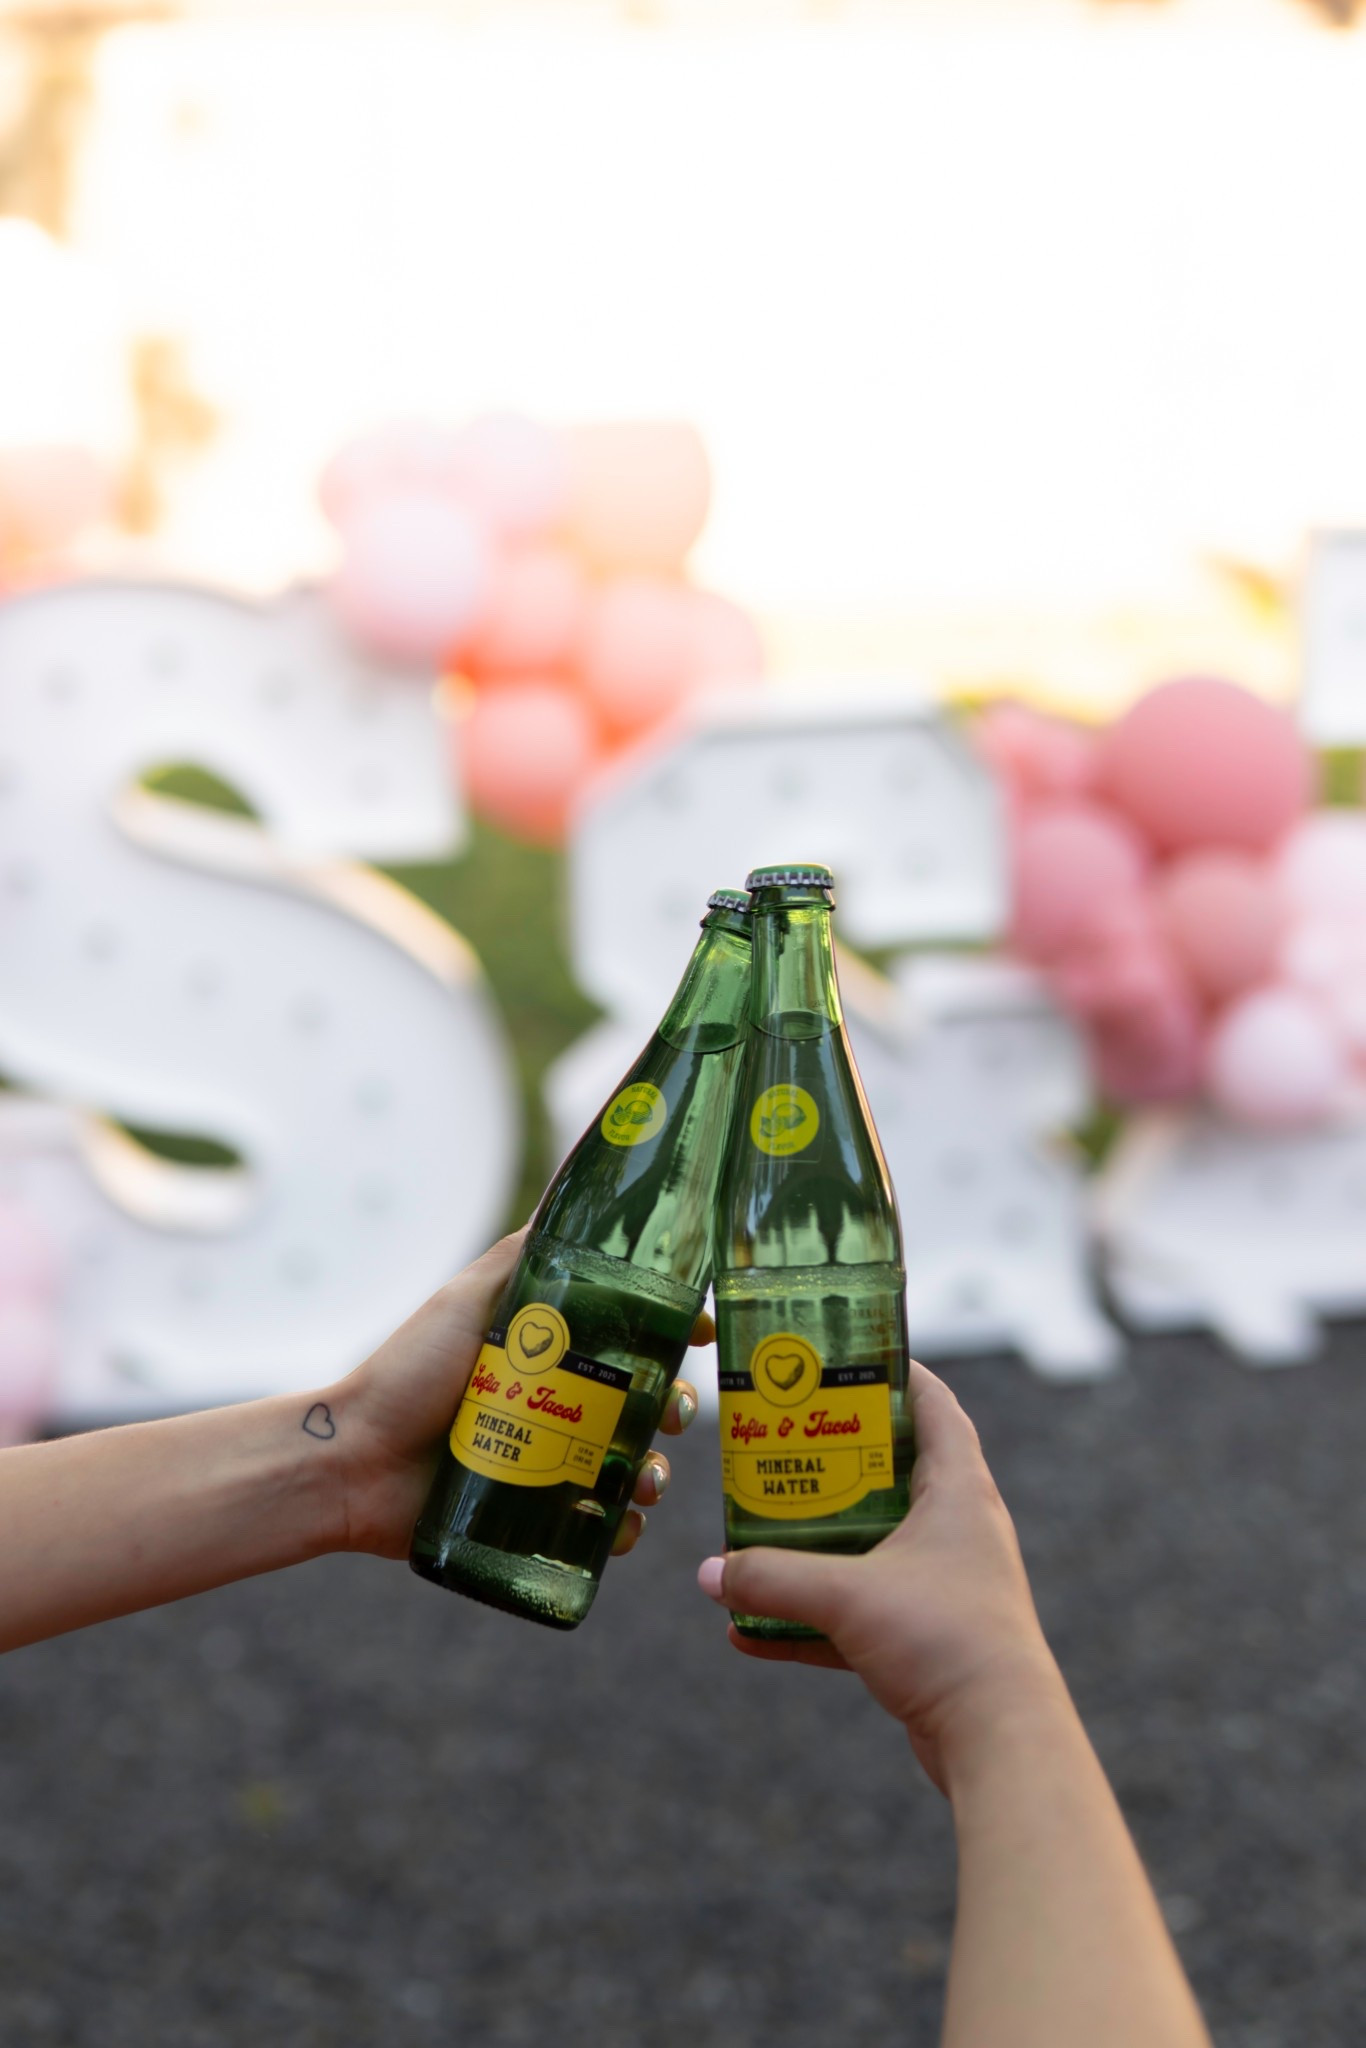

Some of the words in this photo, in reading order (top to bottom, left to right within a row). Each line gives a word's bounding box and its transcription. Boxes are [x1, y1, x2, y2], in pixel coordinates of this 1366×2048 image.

[599, 1368, 617, 1382] 2025
[471, 1363, 501, 1396] Sofia
[506, 1381, 523, 1401] &
[527, 1386, 583, 1424] Jacob
[474, 1411, 533, 1446] MINERAL
[731, 1411, 768, 1446] Sofia
[777, 1416, 795, 1439] &
[803, 1409, 862, 1439] Jacob
[471, 1432, 522, 1462] WATER
[756, 1457, 826, 1475] MINERAL
[763, 1478, 821, 1496] WATER
